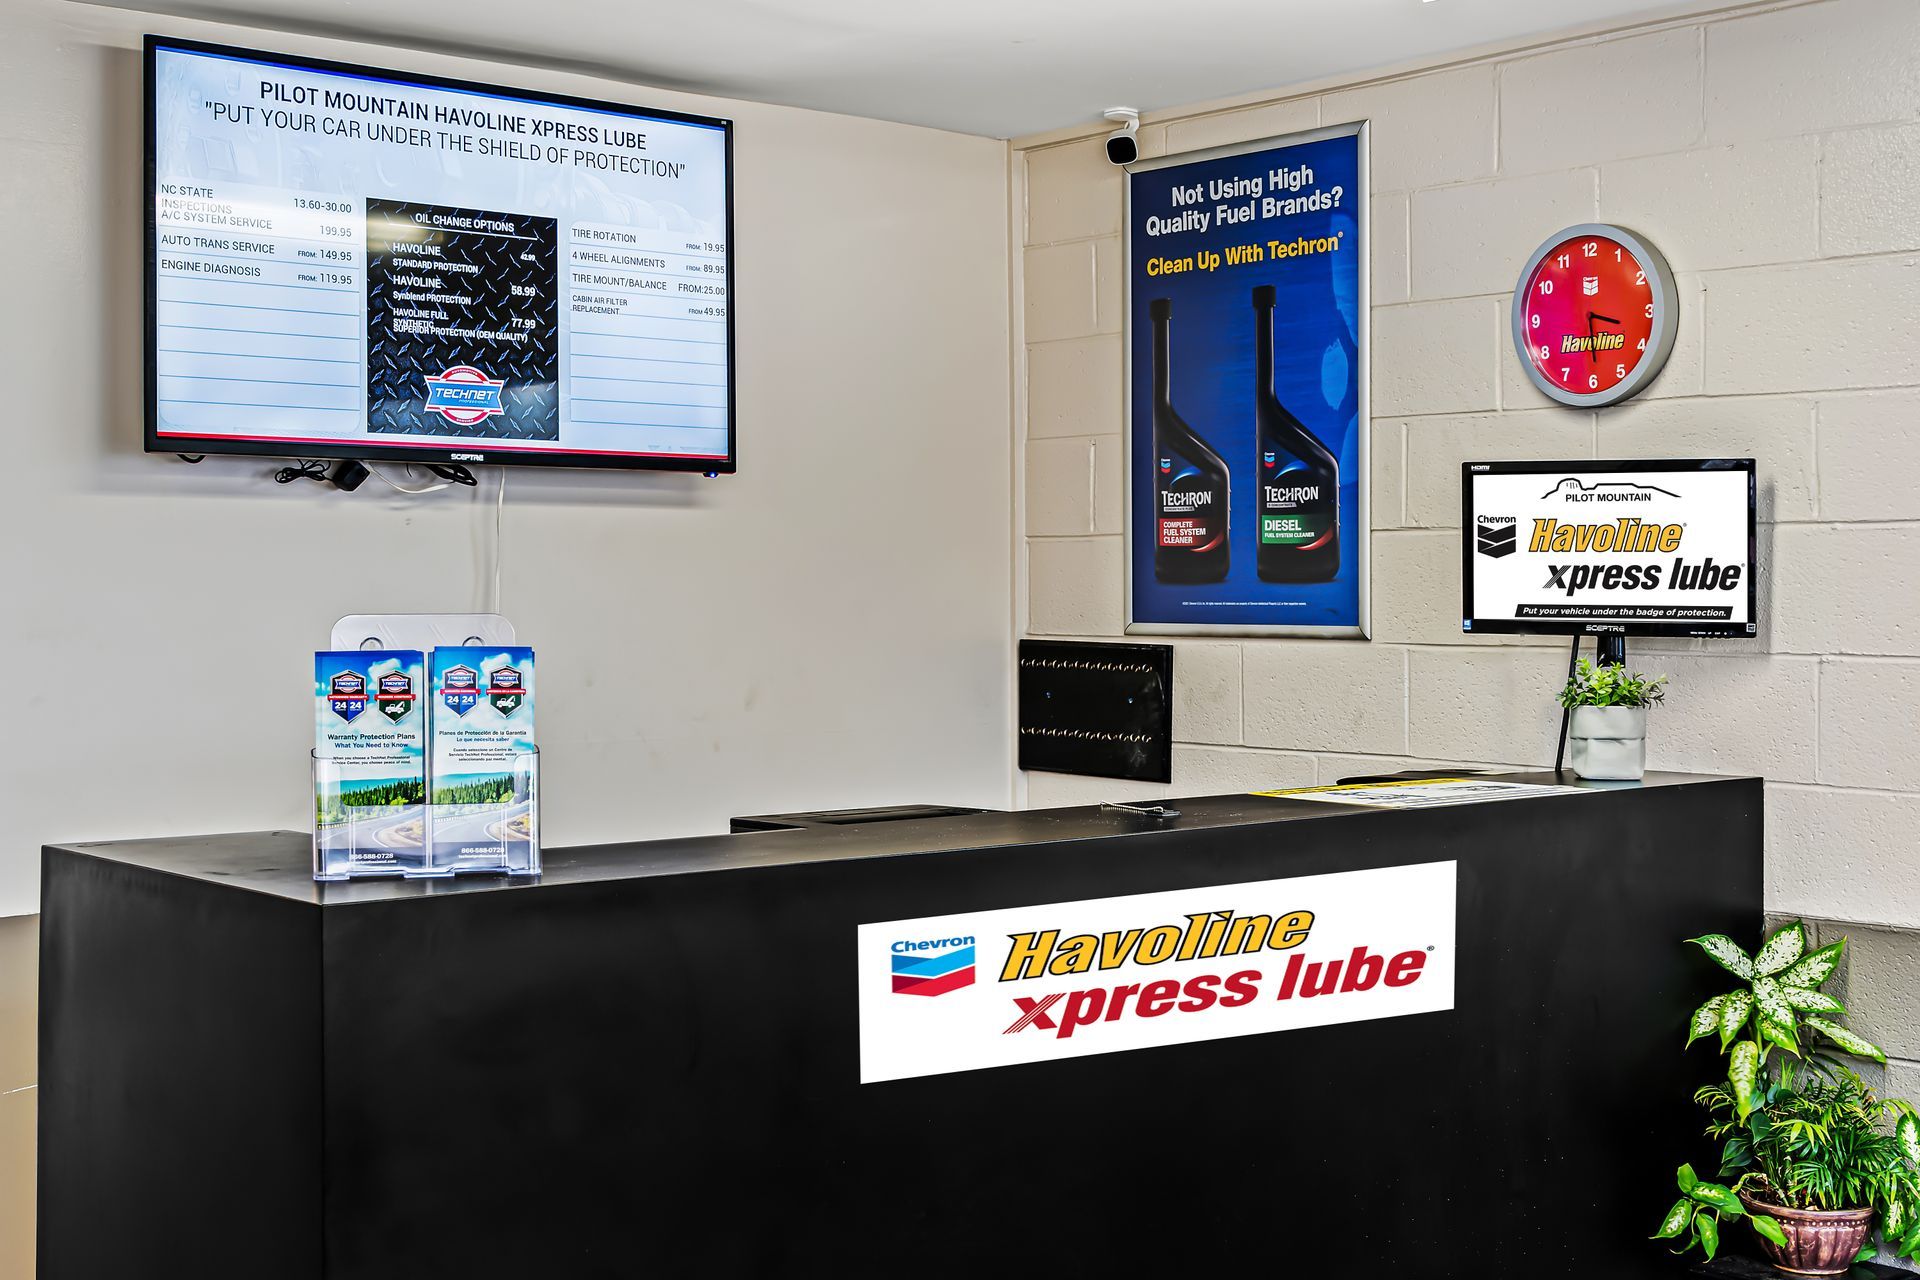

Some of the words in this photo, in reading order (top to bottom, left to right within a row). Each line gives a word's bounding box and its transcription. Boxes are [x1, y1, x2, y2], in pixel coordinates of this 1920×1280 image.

[260, 81, 318, 105] PILOT
[325, 90, 428, 121] MOUNTAIN
[435, 106, 526, 134] HAVOLINE
[532, 120, 598, 143] XPRESS
[604, 129, 646, 150] LUBE
[261, 109, 316, 132] YOUR
[323, 117, 361, 138] CAR
[368, 123, 432, 147] UNDER
[437, 132, 473, 152] THE
[478, 137, 541, 160] SHIELD
[547, 147, 569, 165] OF
[162, 185, 177, 194] NC
[180, 187, 213, 198] STATE
[1172, 183, 1203, 207] Not
[1209, 176, 1263, 200] Using
[1269, 164, 1313, 190] High
[162, 198, 232, 214] INSPECTIONS
[294, 198, 352, 213] 13.60-30.00
[1146, 210, 1210, 237] Quality
[1216, 200, 1255, 226] Fuel
[1262, 186, 1343, 218] Brands?
[162, 211, 181, 220] A/C
[184, 212, 227, 225] SYSTEM
[230, 217, 273, 229] SERVICE
[416, 213, 431, 224] OIL
[433, 215, 472, 228] CHANGE
[474, 220, 515, 232] OPTIONS
[320, 225, 352, 237] 199.95
[572, 228, 591, 238] TIRE
[594, 231, 636, 243] ROTATION
[162, 235, 190, 246] AUTO
[194, 237, 229, 250] TRANS
[232, 241, 275, 254] SERVICE
[393, 242, 441, 255] HAVOLINE
[704, 242, 724, 252] 19.95
[1582, 242, 1598, 257] 12
[320, 249, 352, 261] 149.95
[520, 253, 536, 261] 42.99
[572, 251, 577, 260] 4
[579, 252, 609, 263] WHEEL
[611, 255, 666, 268] ALIGNMENTS
[1147, 256, 1193, 276] Clean
[1197, 251, 1220, 271] Up
[1225, 244, 1263, 266] With
[1557, 254, 1570, 268] 11
[1615, 248, 1622, 263] 1
[162, 259, 200, 272] ENGINE
[204, 262, 261, 276] DIAGNOSIS
[393, 258, 432, 269] STANDARD
[434, 262, 478, 273] PROTECTION
[704, 264, 724, 274] 89.95
[320, 273, 352, 284] 119.95
[393, 275, 442, 288] HAVOLINE
[572, 273, 591, 283] TIRE
[593, 276, 667, 290] MOUNT/BALANCE
[1636, 271, 1646, 286] 2
[511, 285, 536, 297] 58.99
[1539, 280, 1553, 294] 10
[393, 291, 426, 301] Synblend
[426, 293, 471, 305] PROTECTION
[572, 294, 592, 303] CABIN
[606, 298, 627, 306] FILTER
[393, 308, 429, 318] HAVOLINE
[430, 310, 449, 320] FULL
[572, 305, 620, 315] REPLACEMENT
[704, 307, 725, 316] 49.95
[1645, 304, 1654, 318] 3
[393, 318, 434, 328] SYNTHETIC
[511, 318, 536, 329] 77.99
[1532, 314, 1540, 328] 9
[393, 324, 429, 334] SUPERIOR
[430, 326, 476, 338] PROTECTION
[476, 330, 494, 340] (OEM
[496, 332, 528, 343] QUALITY)
[1561, 331, 1625, 354] Havoline
[1637, 338, 1646, 352] 4
[1540, 346, 1550, 360] 8
[1561, 367, 1570, 382] 7
[1616, 364, 1626, 378] 5
[1588, 374, 1598, 388] 6
[451, 453, 484, 461] SCEPTRE
[1161, 490, 1212, 507] TECHRON
[1264, 486, 1319, 505] TECHRON
[1566, 494, 1594, 502] PILOT
[1597, 493, 1651, 502] MOUNTAIN
[1265, 520, 1301, 531] DIESEL
[1477, 515, 1516, 524] Chevron
[1180, 528, 1206, 536] SYSTEM
[1528, 518, 1683, 553] Havoline
[1542, 564, 1663, 597] xpress
[1668, 558, 1742, 591] lube
[1636, 608, 1664, 617] badge
[1677, 608, 1727, 618] protection.
[891, 934, 976, 954] Chevron
[998, 909, 1316, 983] Havoline
[1002, 970, 1260, 1040] xpress
[1276, 945, 1428, 1001] lube
